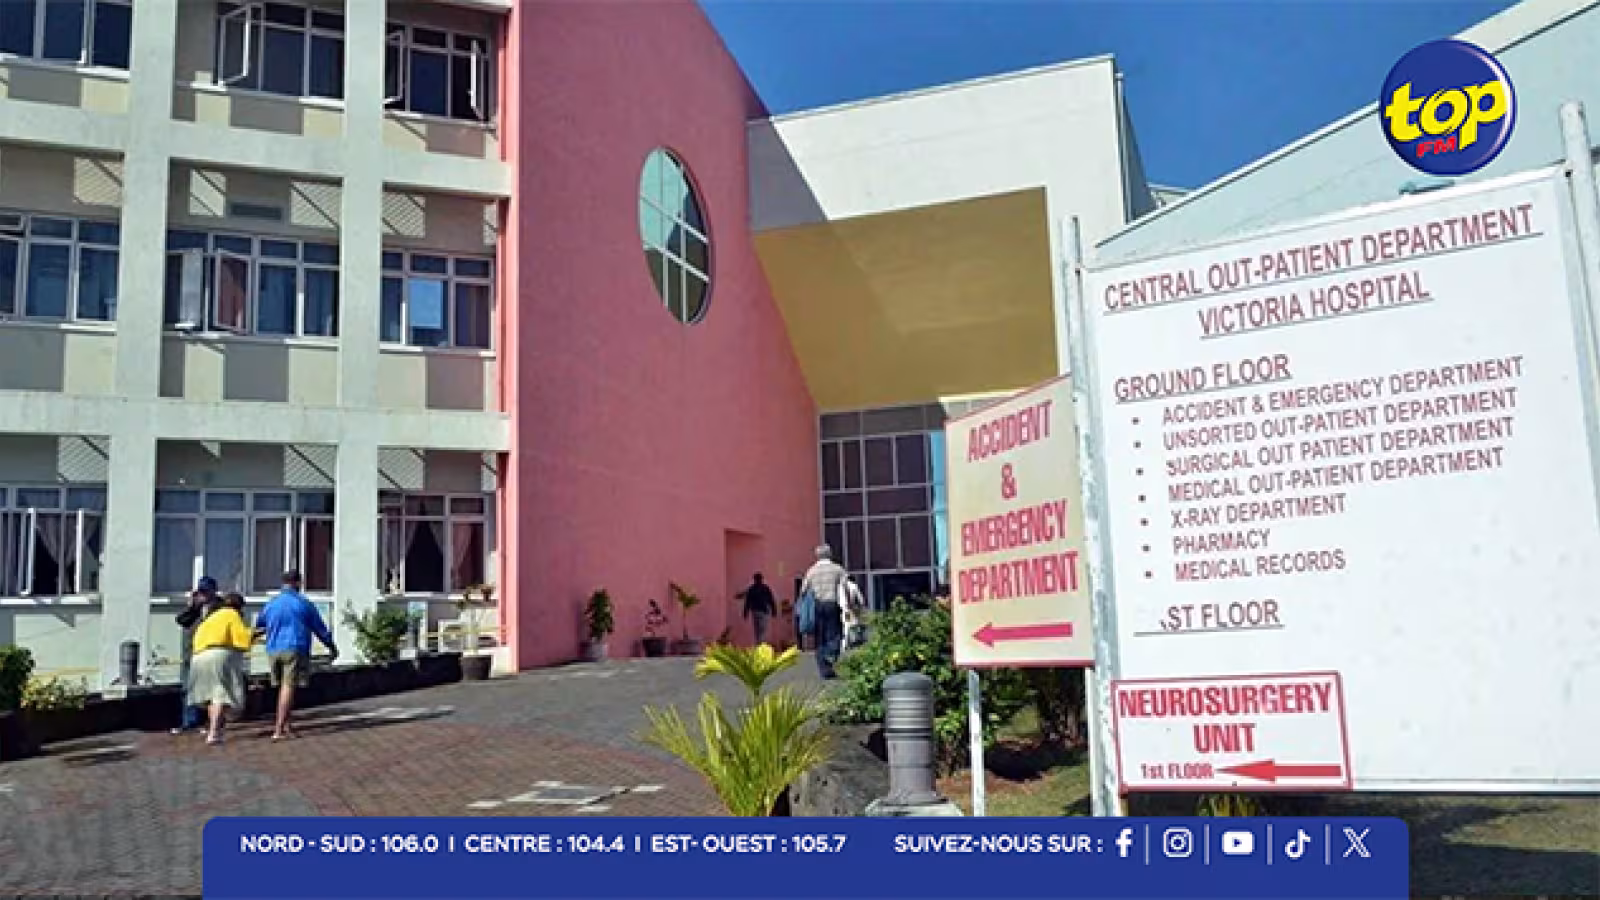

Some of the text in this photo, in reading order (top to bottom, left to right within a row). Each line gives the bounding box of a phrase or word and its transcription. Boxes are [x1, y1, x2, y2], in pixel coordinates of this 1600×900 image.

[1104, 203, 1533, 311] CENTRAL OUT-PATIENT DEPARTMENT
[1198, 270, 1430, 336] VICTORIA HOSPITAL
[1114, 354, 1291, 402] GROUND FLOOR
[1162, 356, 1523, 425] ACCIDENT & EMERGENCY DEPARTMENT
[967, 401, 1052, 463] ACCIDENT
[1163, 387, 1517, 450] UNSORTED OUT-PATIENT DEPARTMENT
[1166, 417, 1514, 476] SURGICAL OUT PATIENT DEPARTMENT
[1001, 463, 1017, 499] &
[1168, 446, 1503, 503] MEDICAL OUT-PATIENT DEPARTMENT
[961, 499, 1068, 557] EMERGENCY
[1171, 493, 1346, 528] X-RAY DEPARTMENT
[1172, 529, 1270, 556] PHARMACY
[1175, 548, 1346, 582] MEDICAL RECORDS
[958, 551, 1078, 605] DEPARTMENT
[1160, 599, 1280, 631] ST FLOOR
[1118, 682, 1331, 718] NEUROSURGERY
[1193, 722, 1256, 754] UNIT
[1140, 763, 1214, 780] 1st FLOOR
